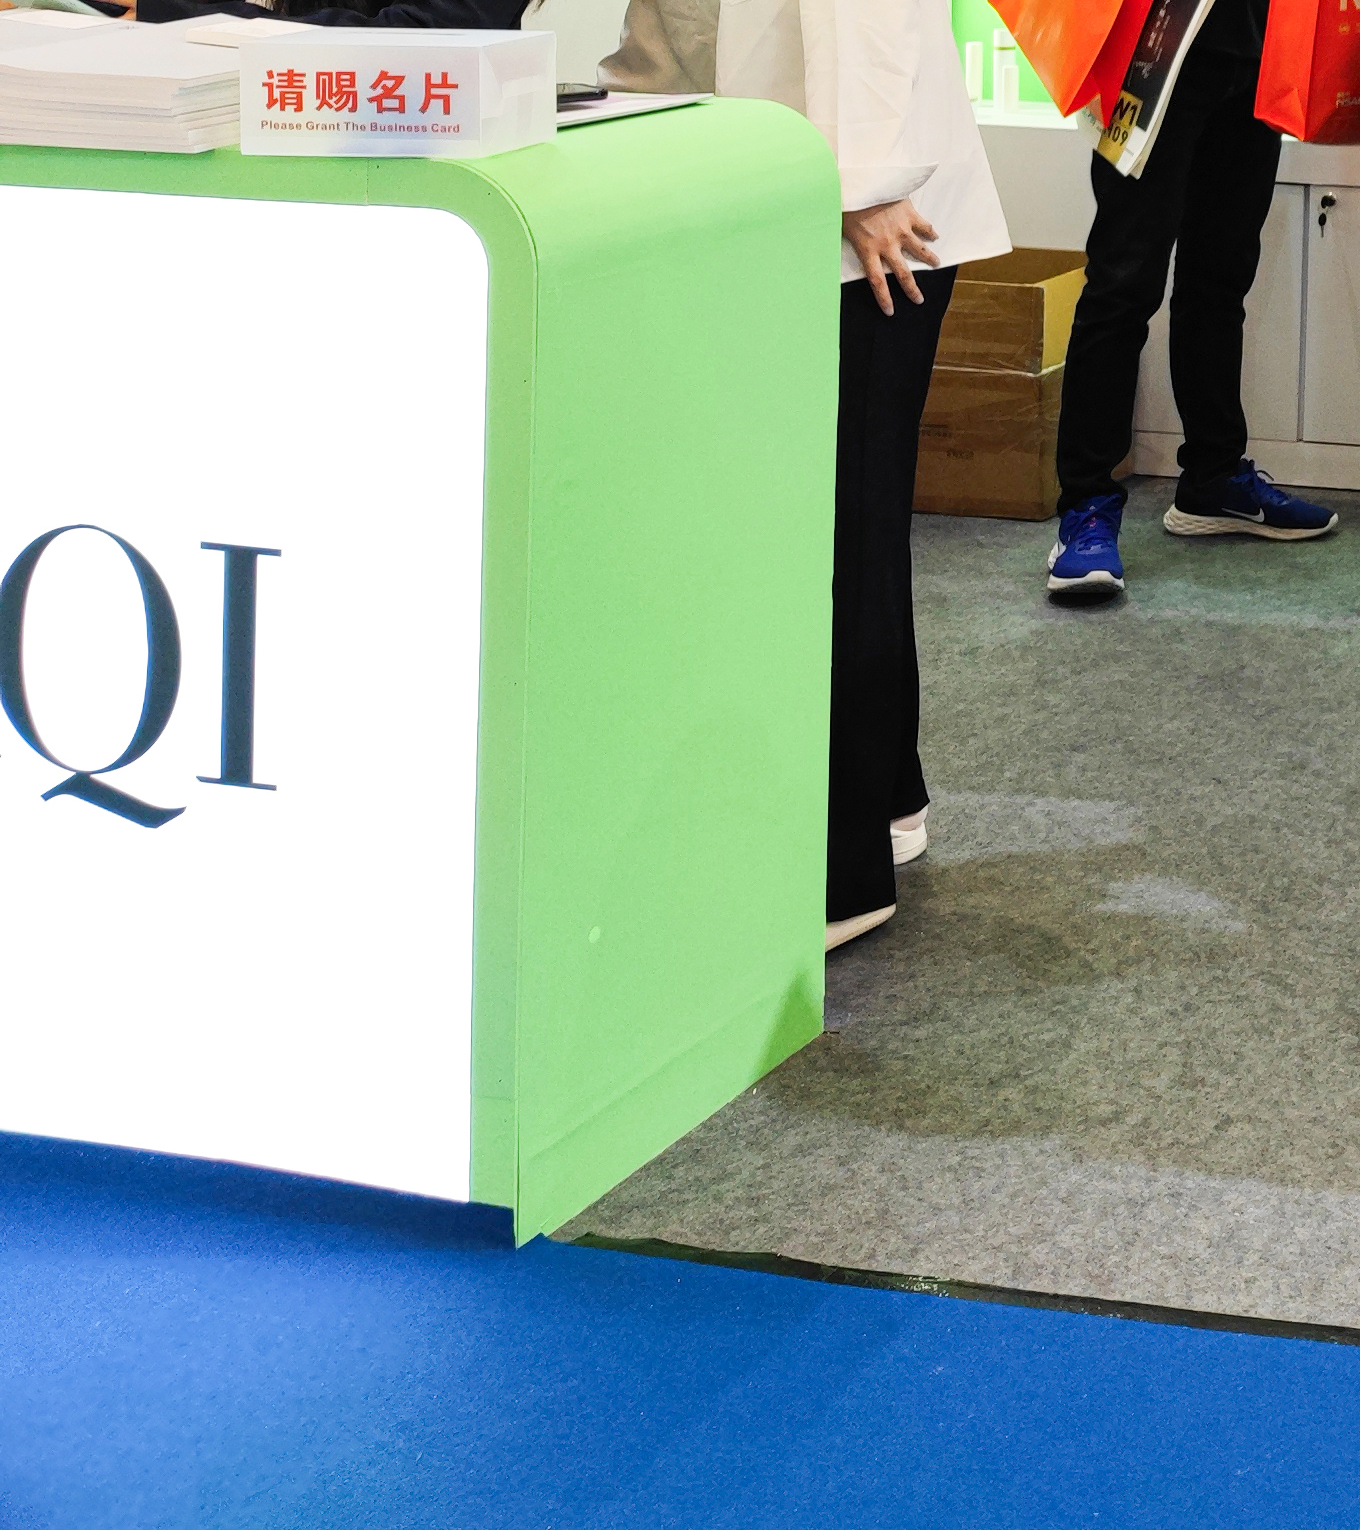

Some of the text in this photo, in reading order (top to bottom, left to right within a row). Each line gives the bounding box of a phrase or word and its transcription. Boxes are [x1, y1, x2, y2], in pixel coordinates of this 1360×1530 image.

[261, 68, 460, 116] 请赐名片
[260, 120, 461, 134] Please Grant The Business Card
